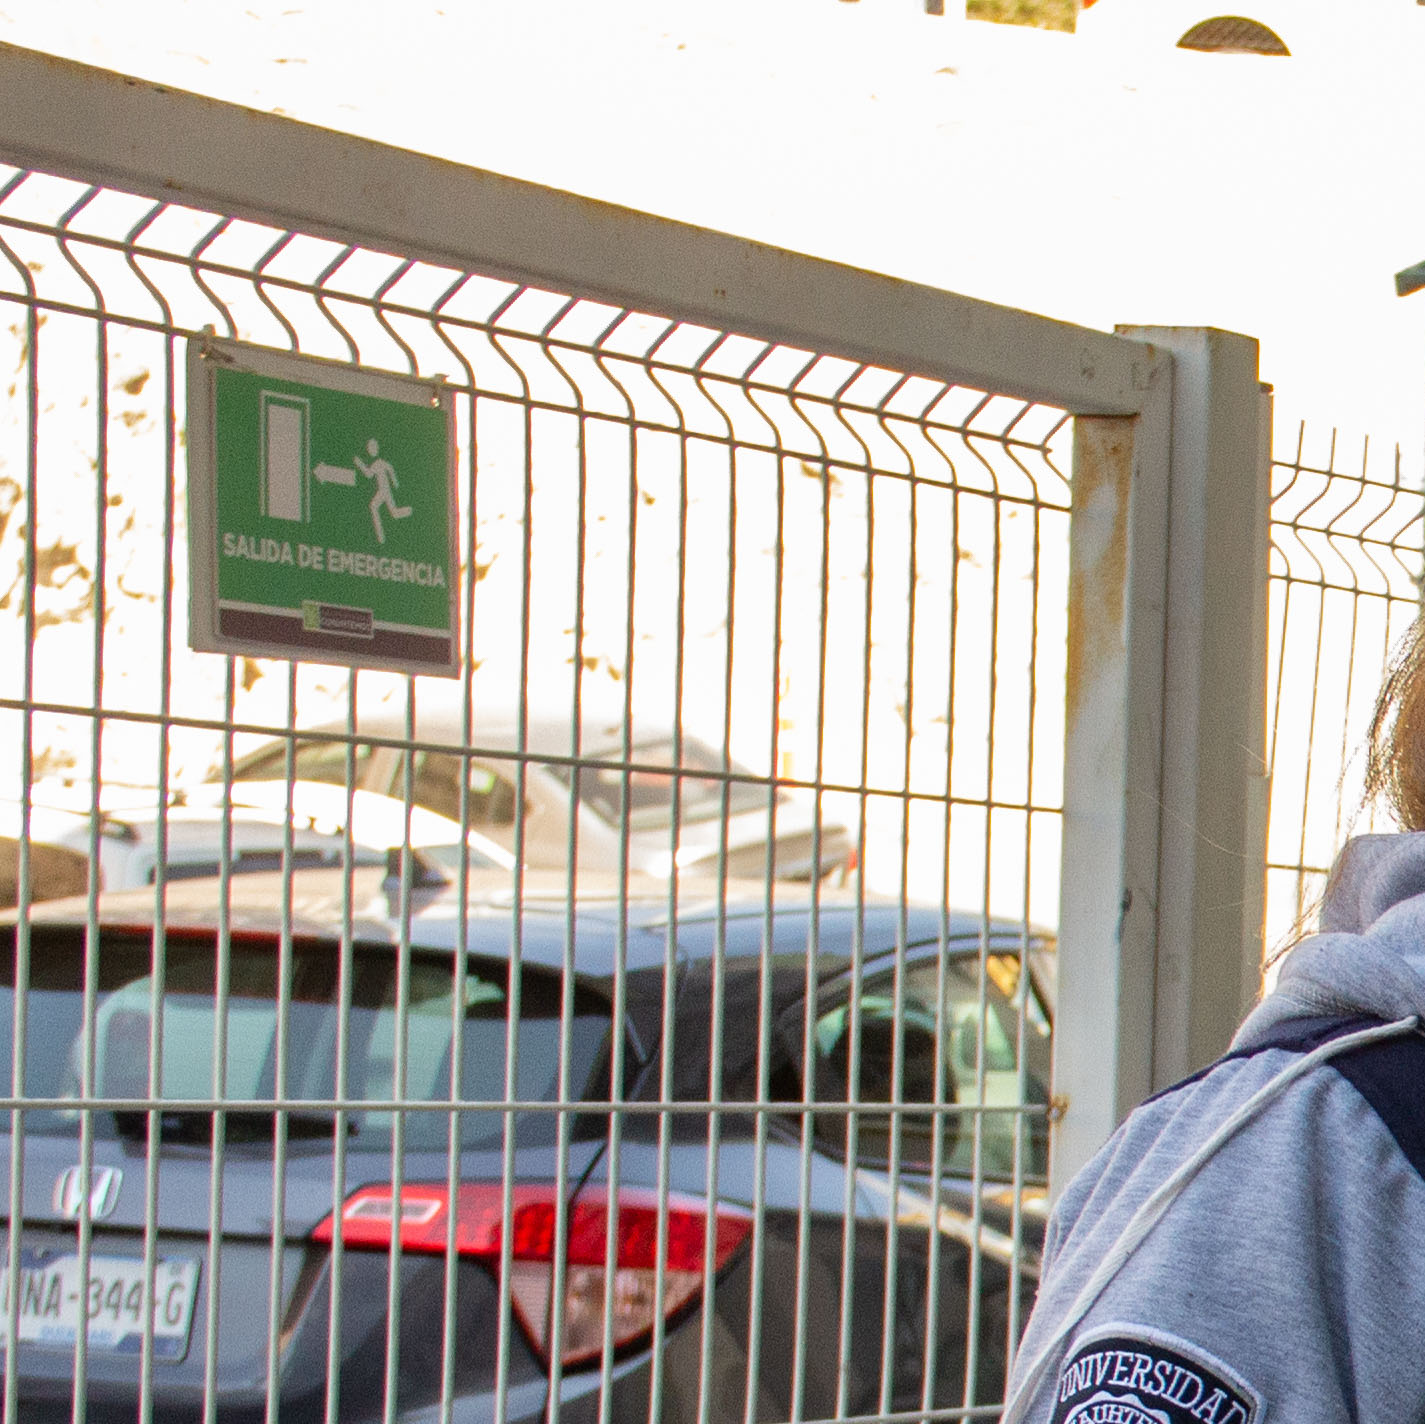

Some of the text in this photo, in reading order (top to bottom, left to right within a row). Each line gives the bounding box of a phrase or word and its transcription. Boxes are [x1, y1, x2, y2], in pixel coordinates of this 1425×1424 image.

[222, 532, 446, 587] SALIDA DE EMERGENCIA
